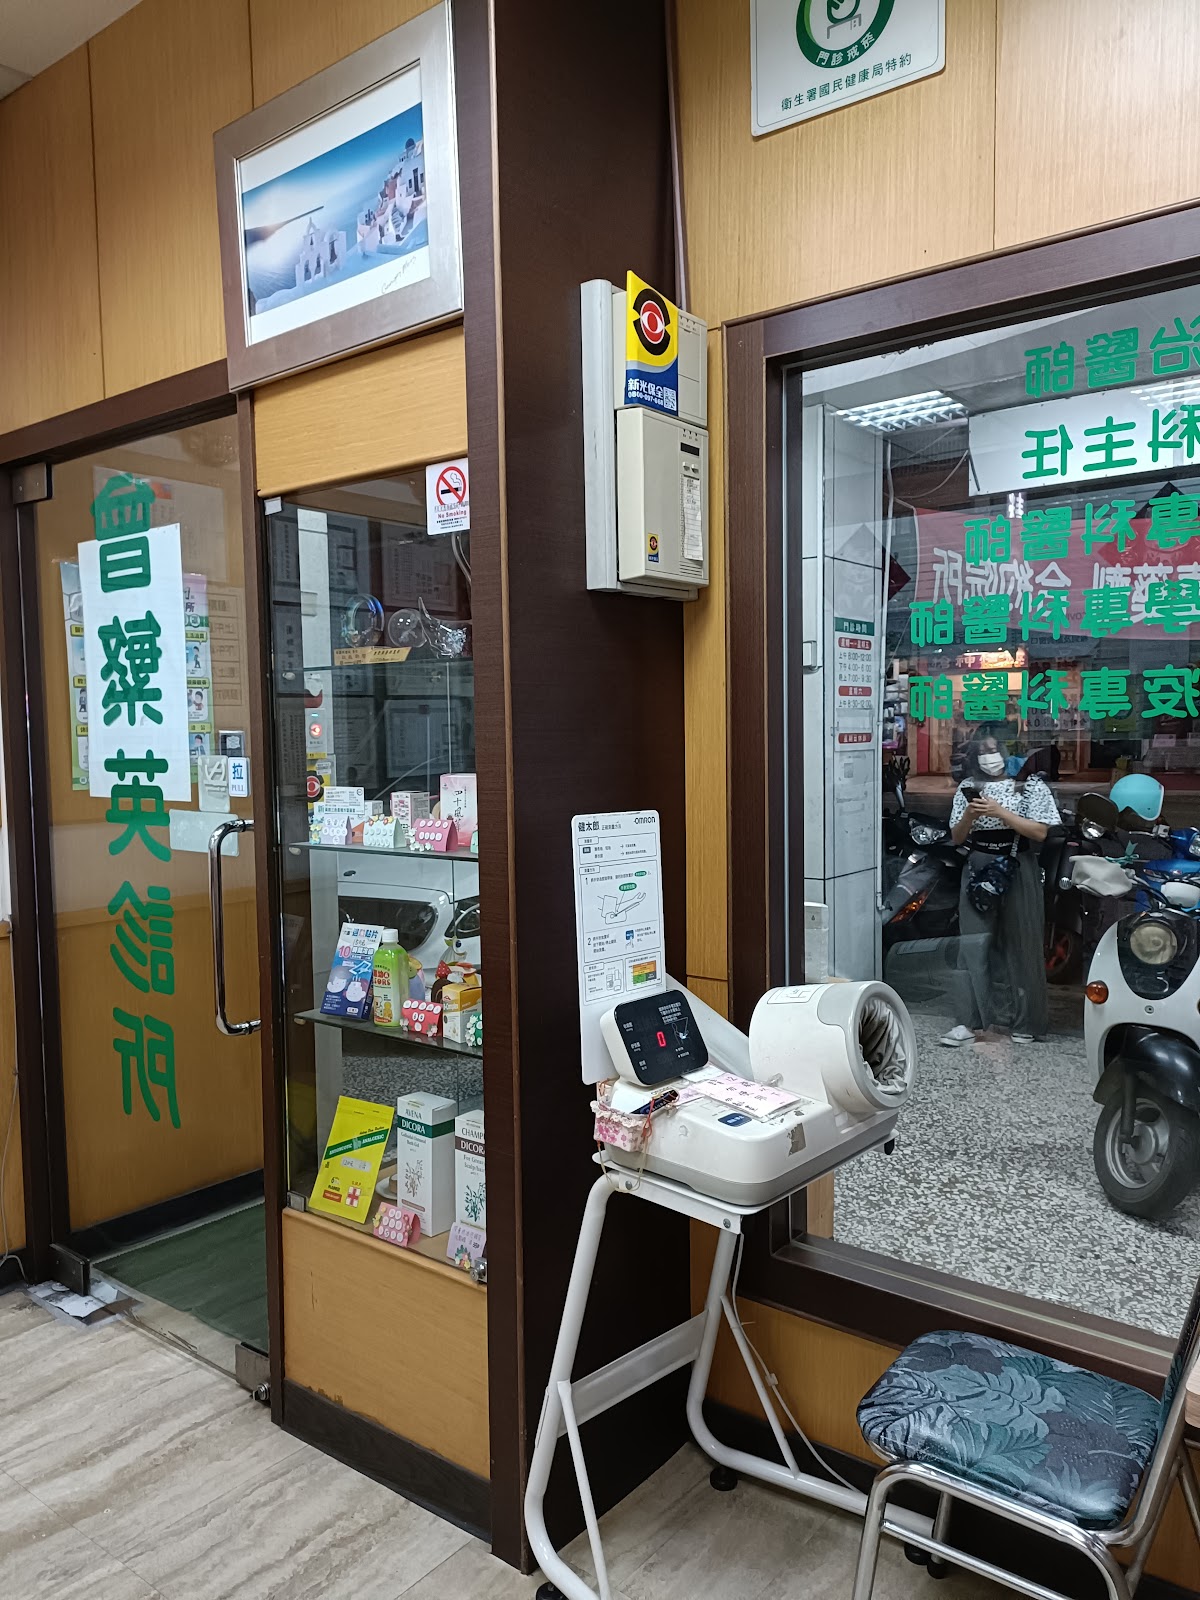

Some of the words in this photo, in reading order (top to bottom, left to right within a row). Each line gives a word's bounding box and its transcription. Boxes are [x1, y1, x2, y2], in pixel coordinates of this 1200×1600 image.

[781, 52, 912, 111] 衛生署國民健康局特約
[628, 378, 663, 399] 新光保全
[232, 763, 244, 780] 拉
[232, 784, 244, 792] PULL
[578, 821, 599, 833] 健太郎
[656, 1031, 666, 1047] 0
[406, 1109, 422, 1120] AVENA
[401, 1119, 425, 1134] DICORA
